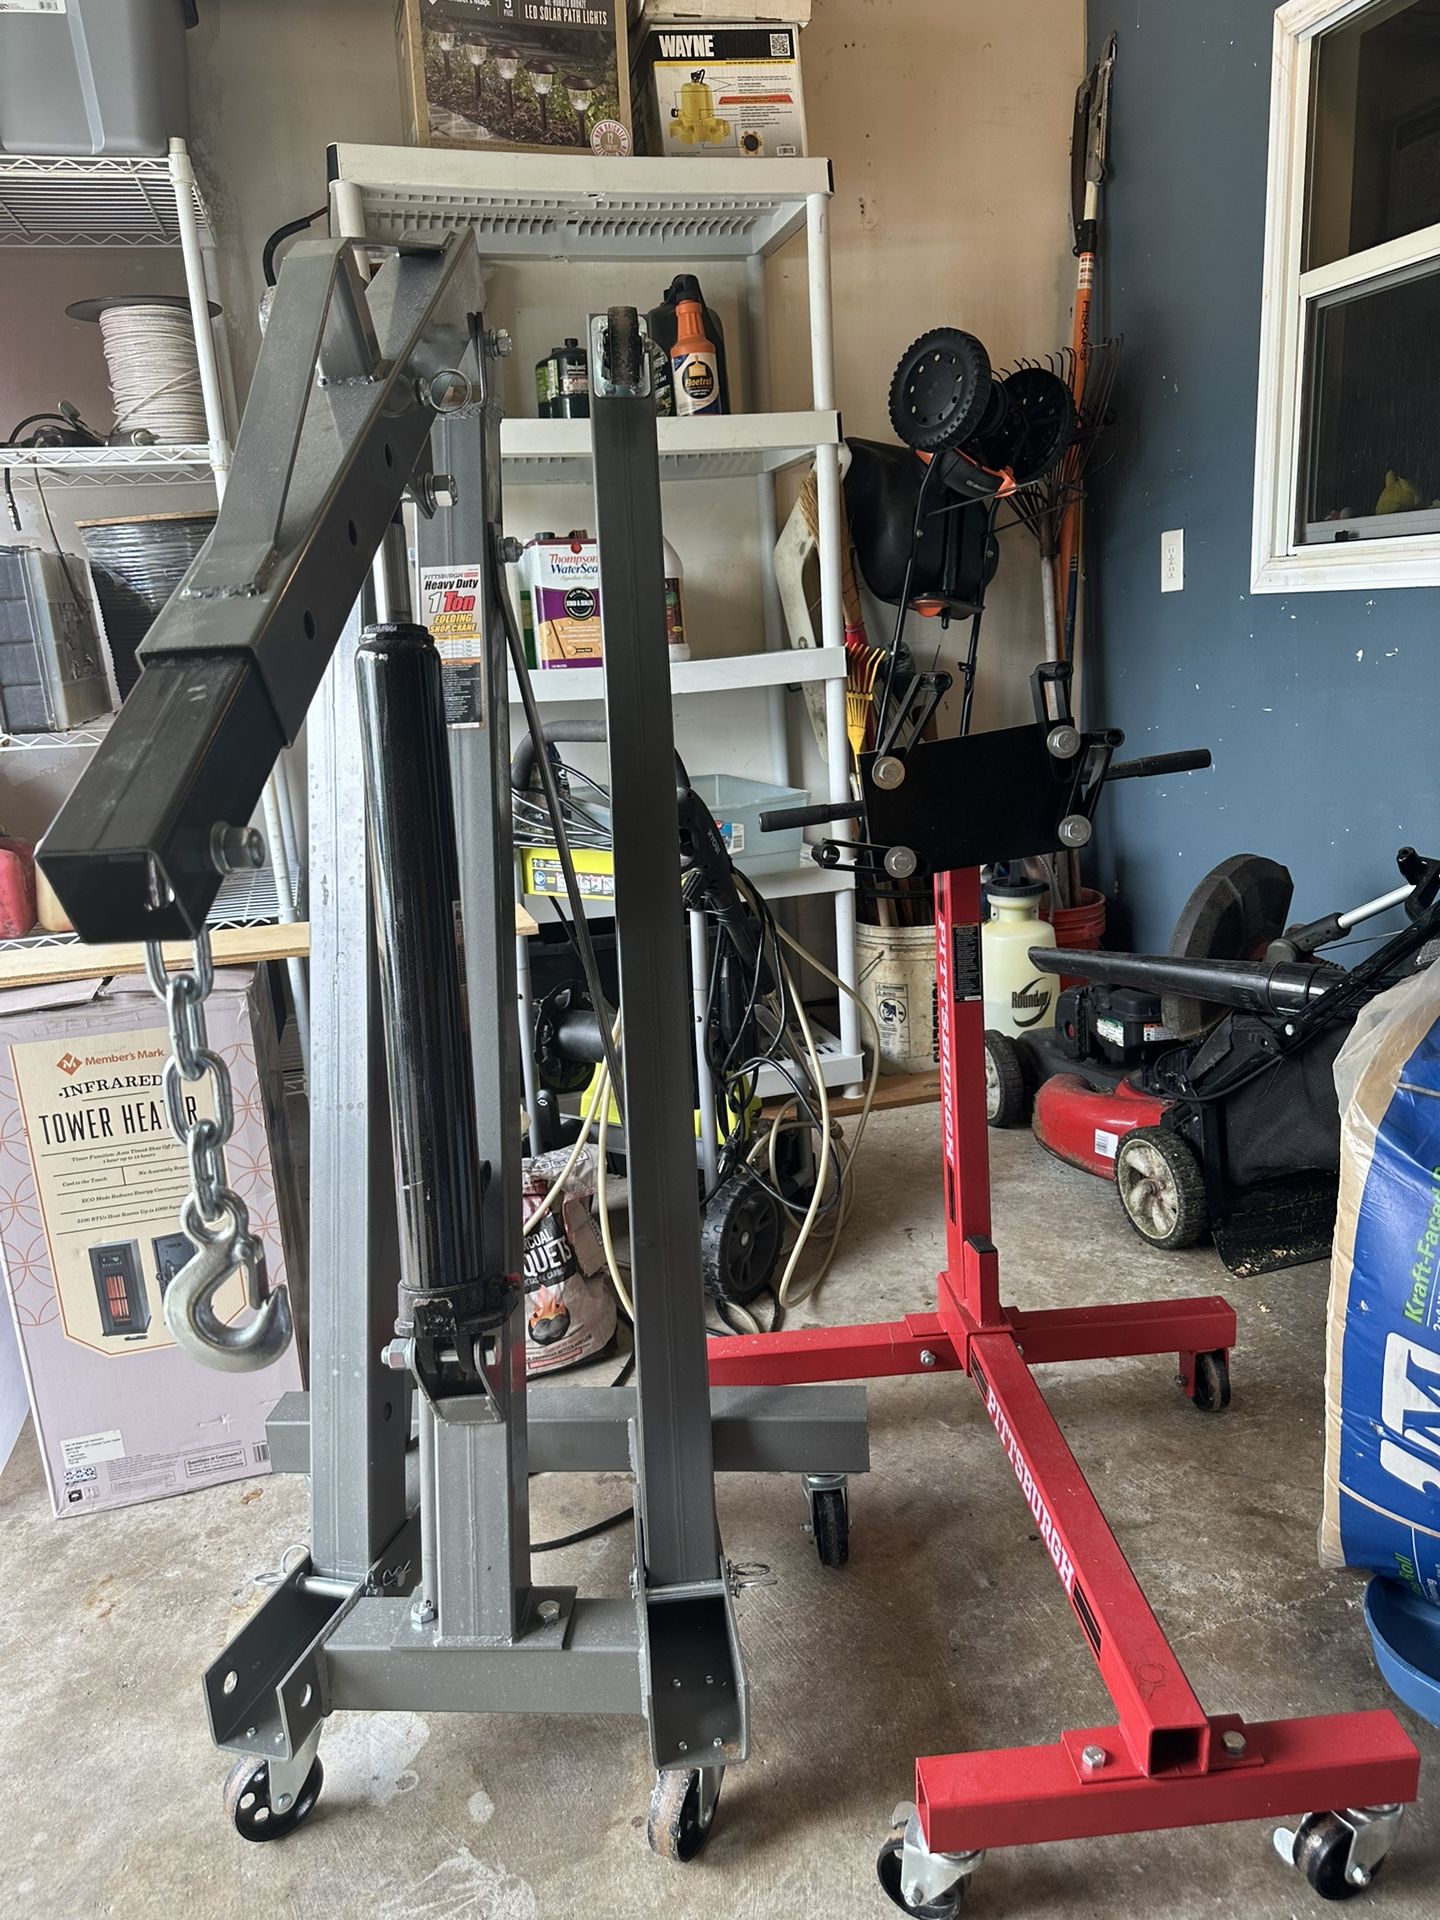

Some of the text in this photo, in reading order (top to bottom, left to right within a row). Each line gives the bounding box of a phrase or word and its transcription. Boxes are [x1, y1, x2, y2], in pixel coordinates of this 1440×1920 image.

[524, 4, 608, 26] LED SOLAR PATH LIGHTS
[658, 35, 714, 57] WAYNE
[1081, 300, 1091, 361] FISKARS
[424, 572, 464, 580] PITTSBURGH
[424, 578, 479, 590] Heavy Duty
[429, 590, 476, 613] 1 Ton
[429, 622, 478, 634] SHOP CRANE
[434, 613, 473, 625] FOLDING
[1012, 989, 1049, 1011] Roundup
[938, 914, 954, 1166] PITTSBURGH
[85, 1049, 165, 1066] Member's Mark
[62, 1074, 162, 1098] INFRARED
[38, 1095, 198, 1145] TOWER HEAR
[986, 1385, 1075, 1596] PITTSBURGH
